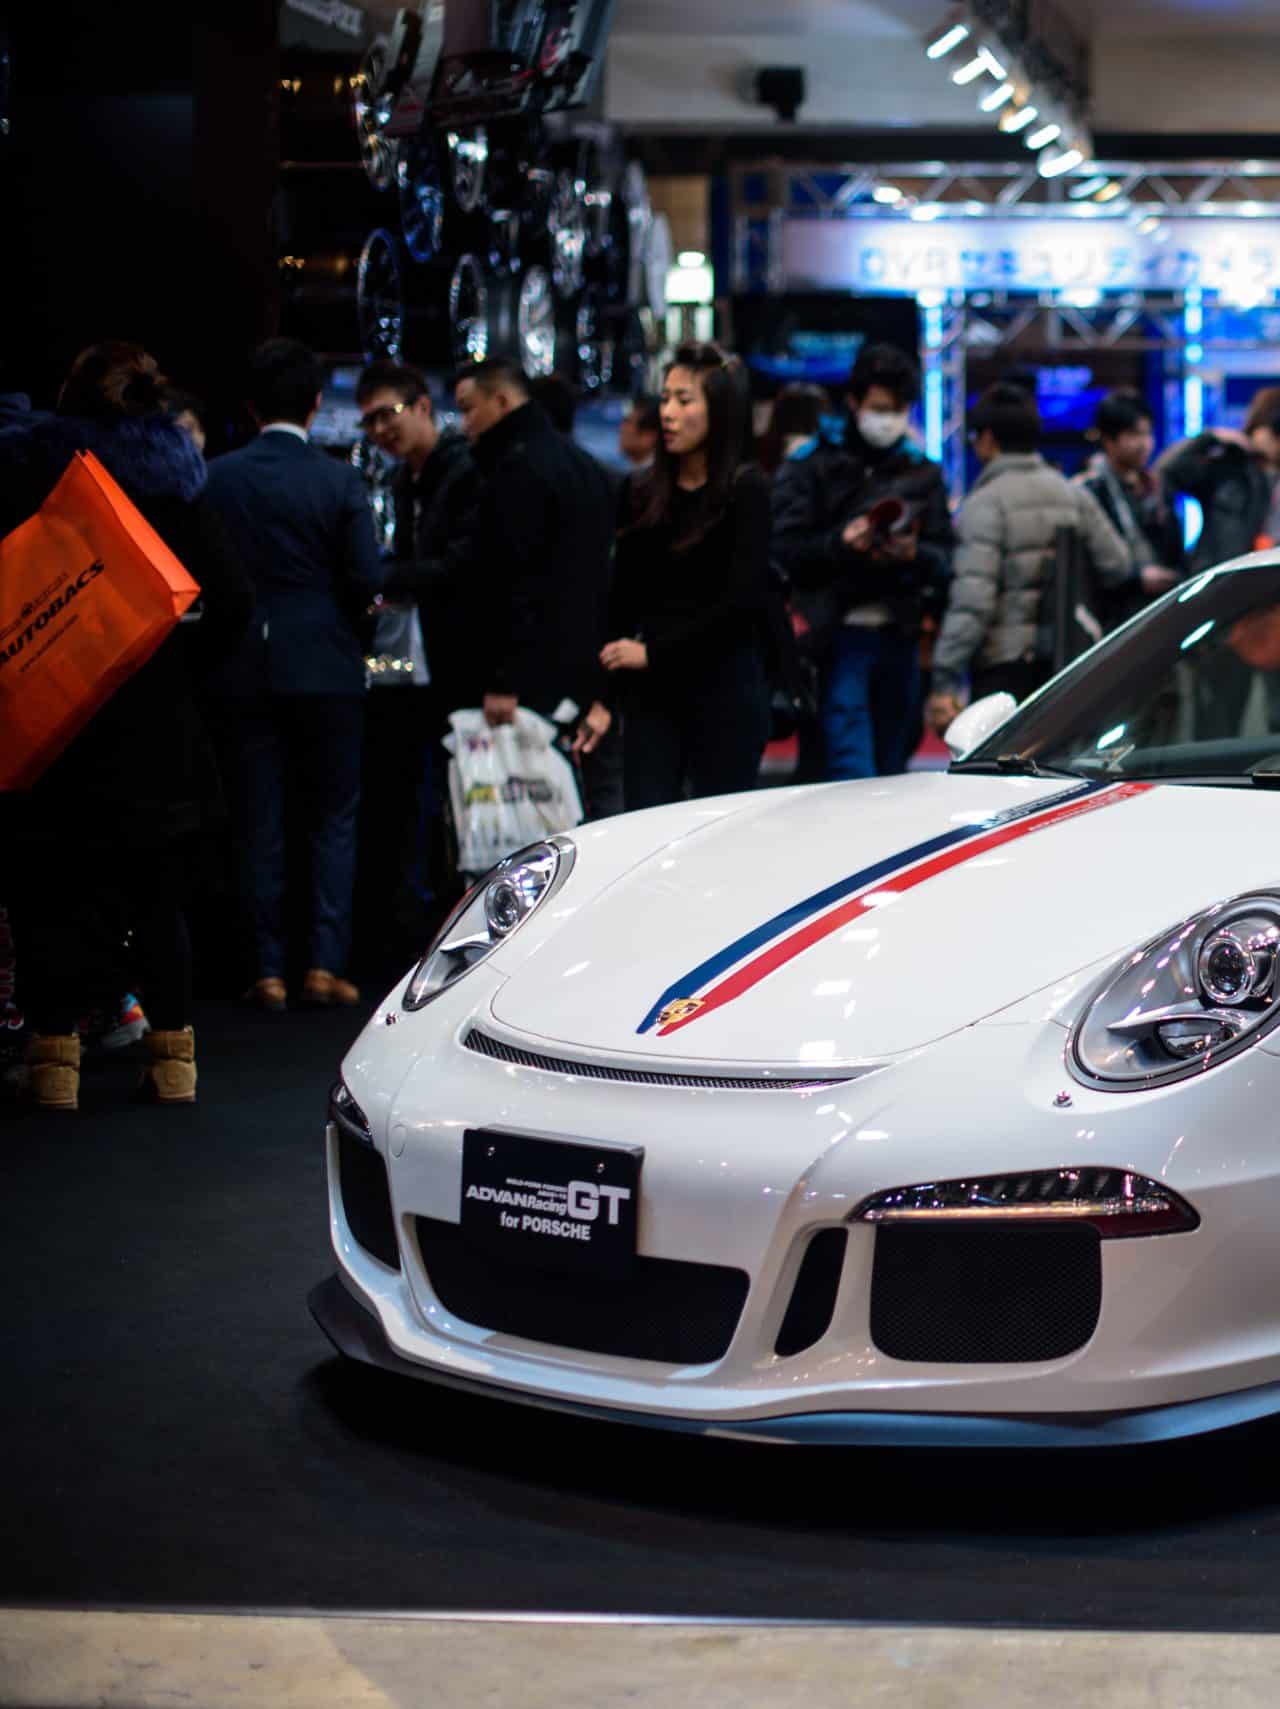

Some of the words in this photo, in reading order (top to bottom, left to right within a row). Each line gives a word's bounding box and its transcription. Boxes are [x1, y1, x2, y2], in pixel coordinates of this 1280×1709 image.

[568, 1181, 631, 1224] GT
[500, 1211, 520, 1229] for
[522, 1215, 591, 1241] PORSCHE
